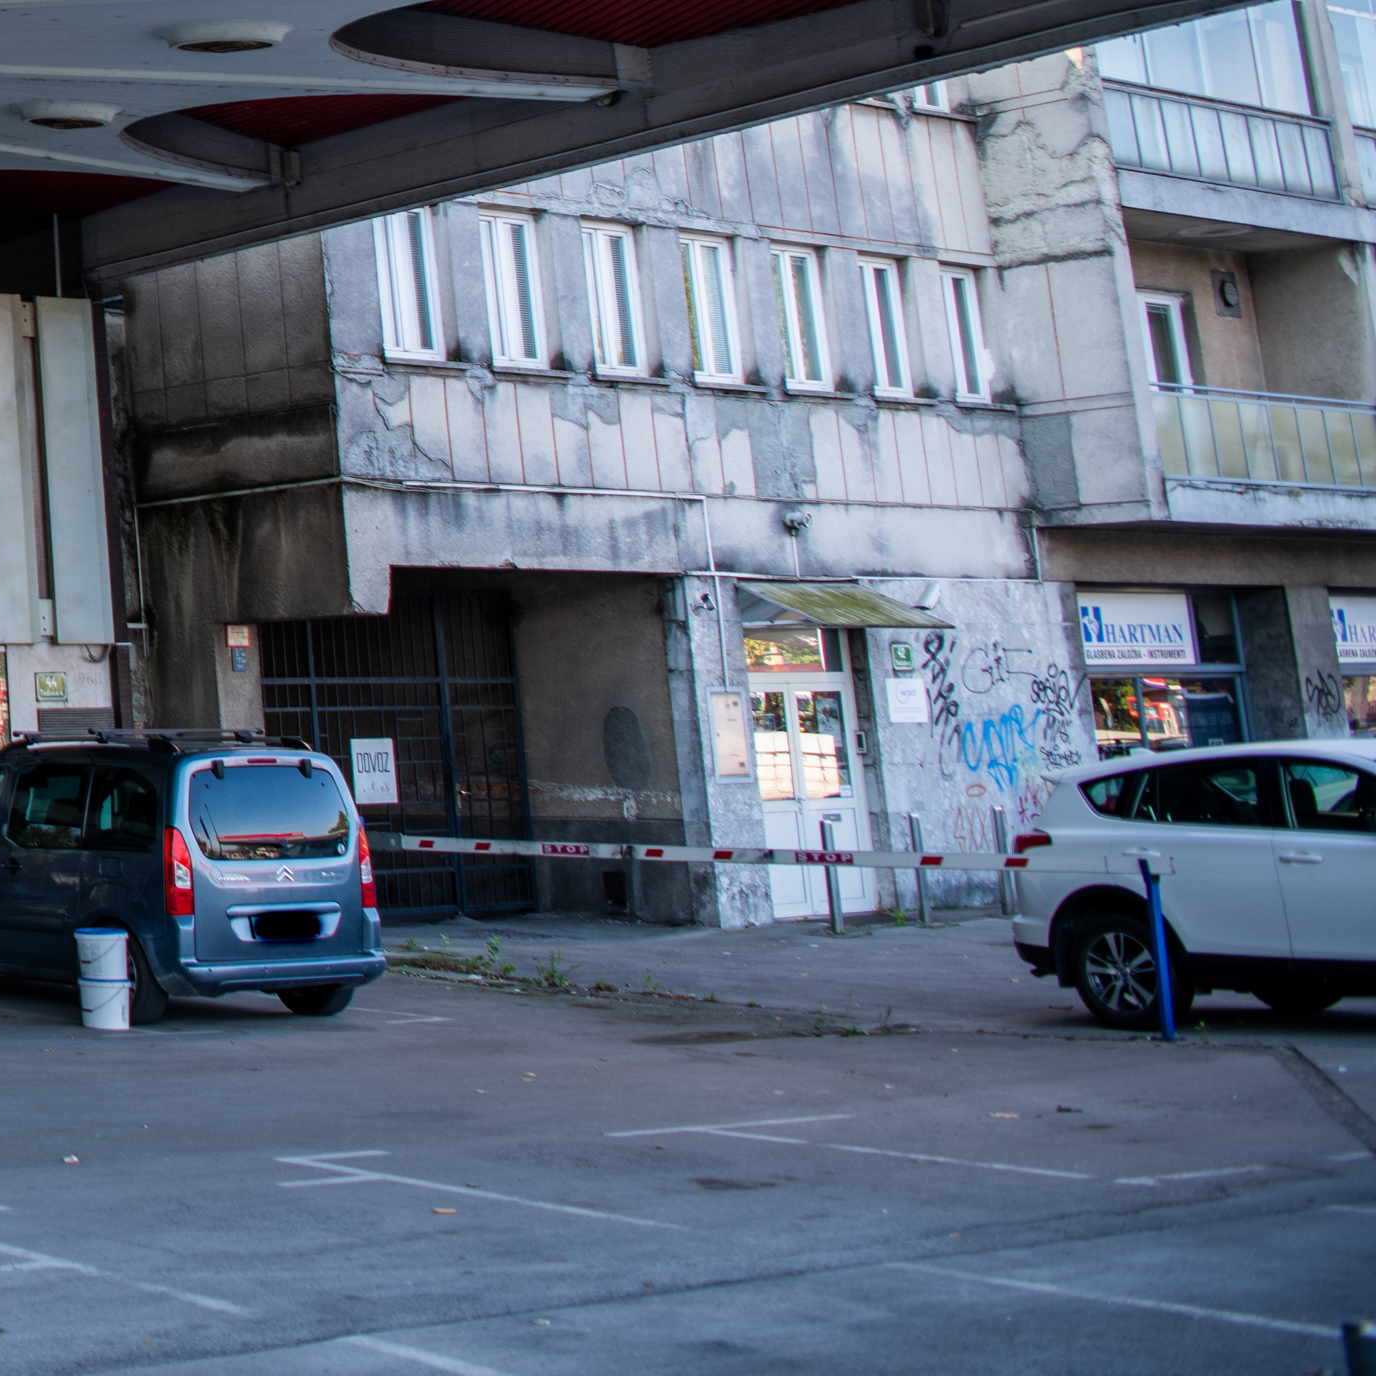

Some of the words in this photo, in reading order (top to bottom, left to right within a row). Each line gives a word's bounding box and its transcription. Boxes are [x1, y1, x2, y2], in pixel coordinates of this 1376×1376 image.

[1104, 624, 1184, 643] HARTMAN
[1086, 649, 1116, 660] GLASBENA
[1147, 649, 1187, 660] INSTRUMENTI
[45, 675, 58, 689] 44
[356, 751, 391, 773] DOVOZ
[544, 844, 588, 854] STOP
[797, 852, 852, 863] STOP
